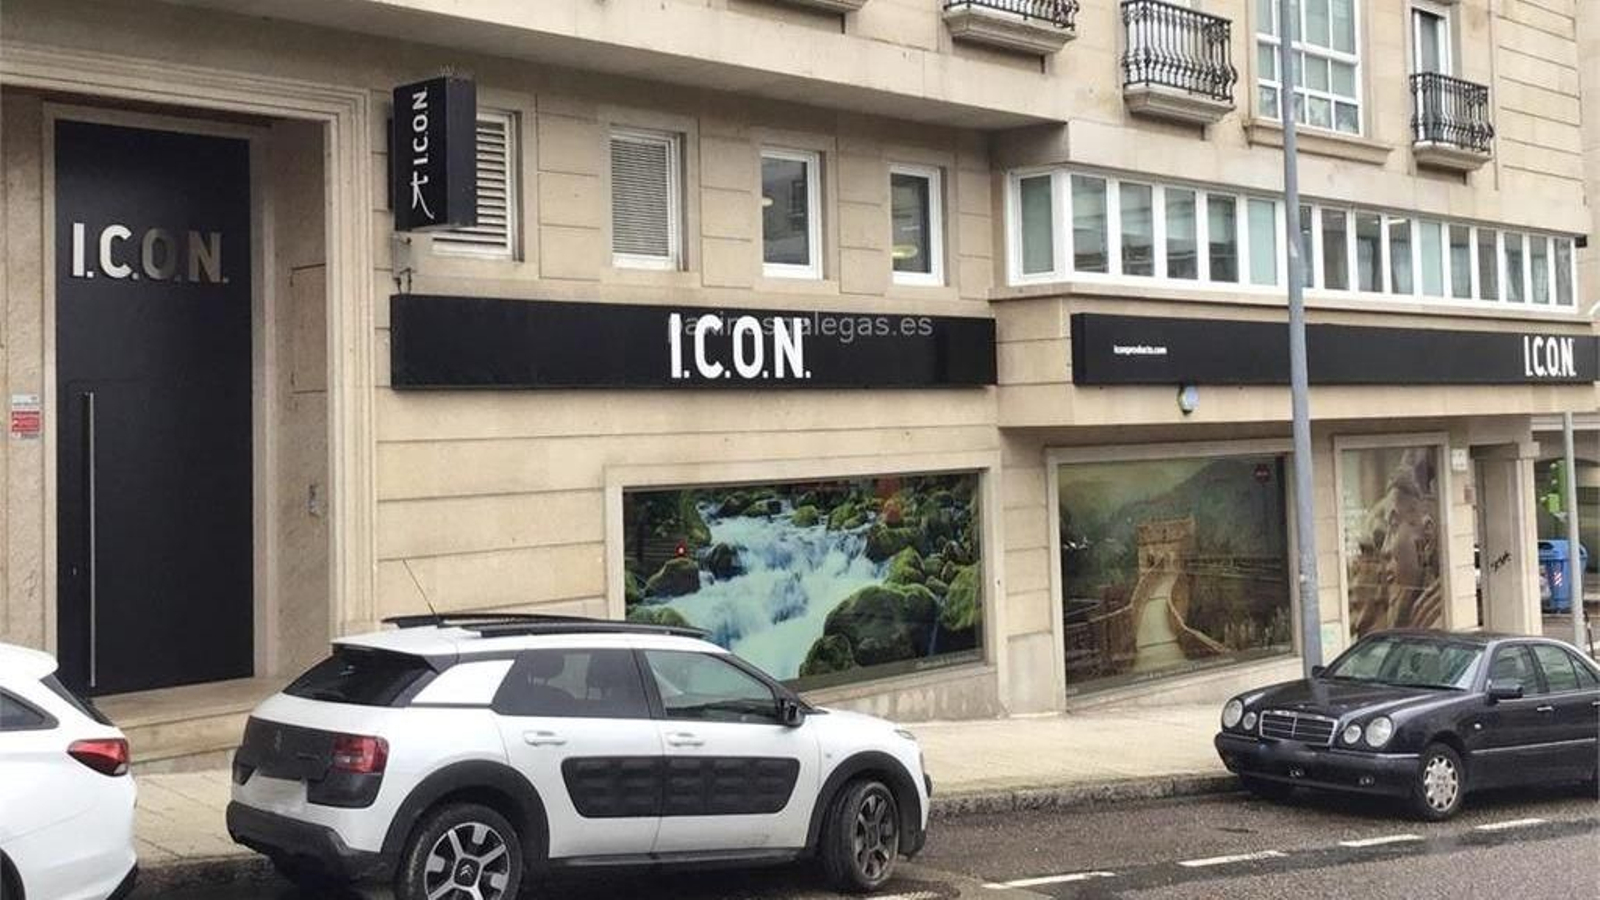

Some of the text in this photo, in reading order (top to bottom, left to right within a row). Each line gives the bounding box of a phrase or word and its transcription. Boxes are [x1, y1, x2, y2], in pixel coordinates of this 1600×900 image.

[412, 87, 429, 166] I.C.O.N.
[73, 223, 229, 283] I.C.O.N.
[670, 312, 812, 379] I.C.O.N.
[1524, 335, 1577, 377] I.C.O.N.
